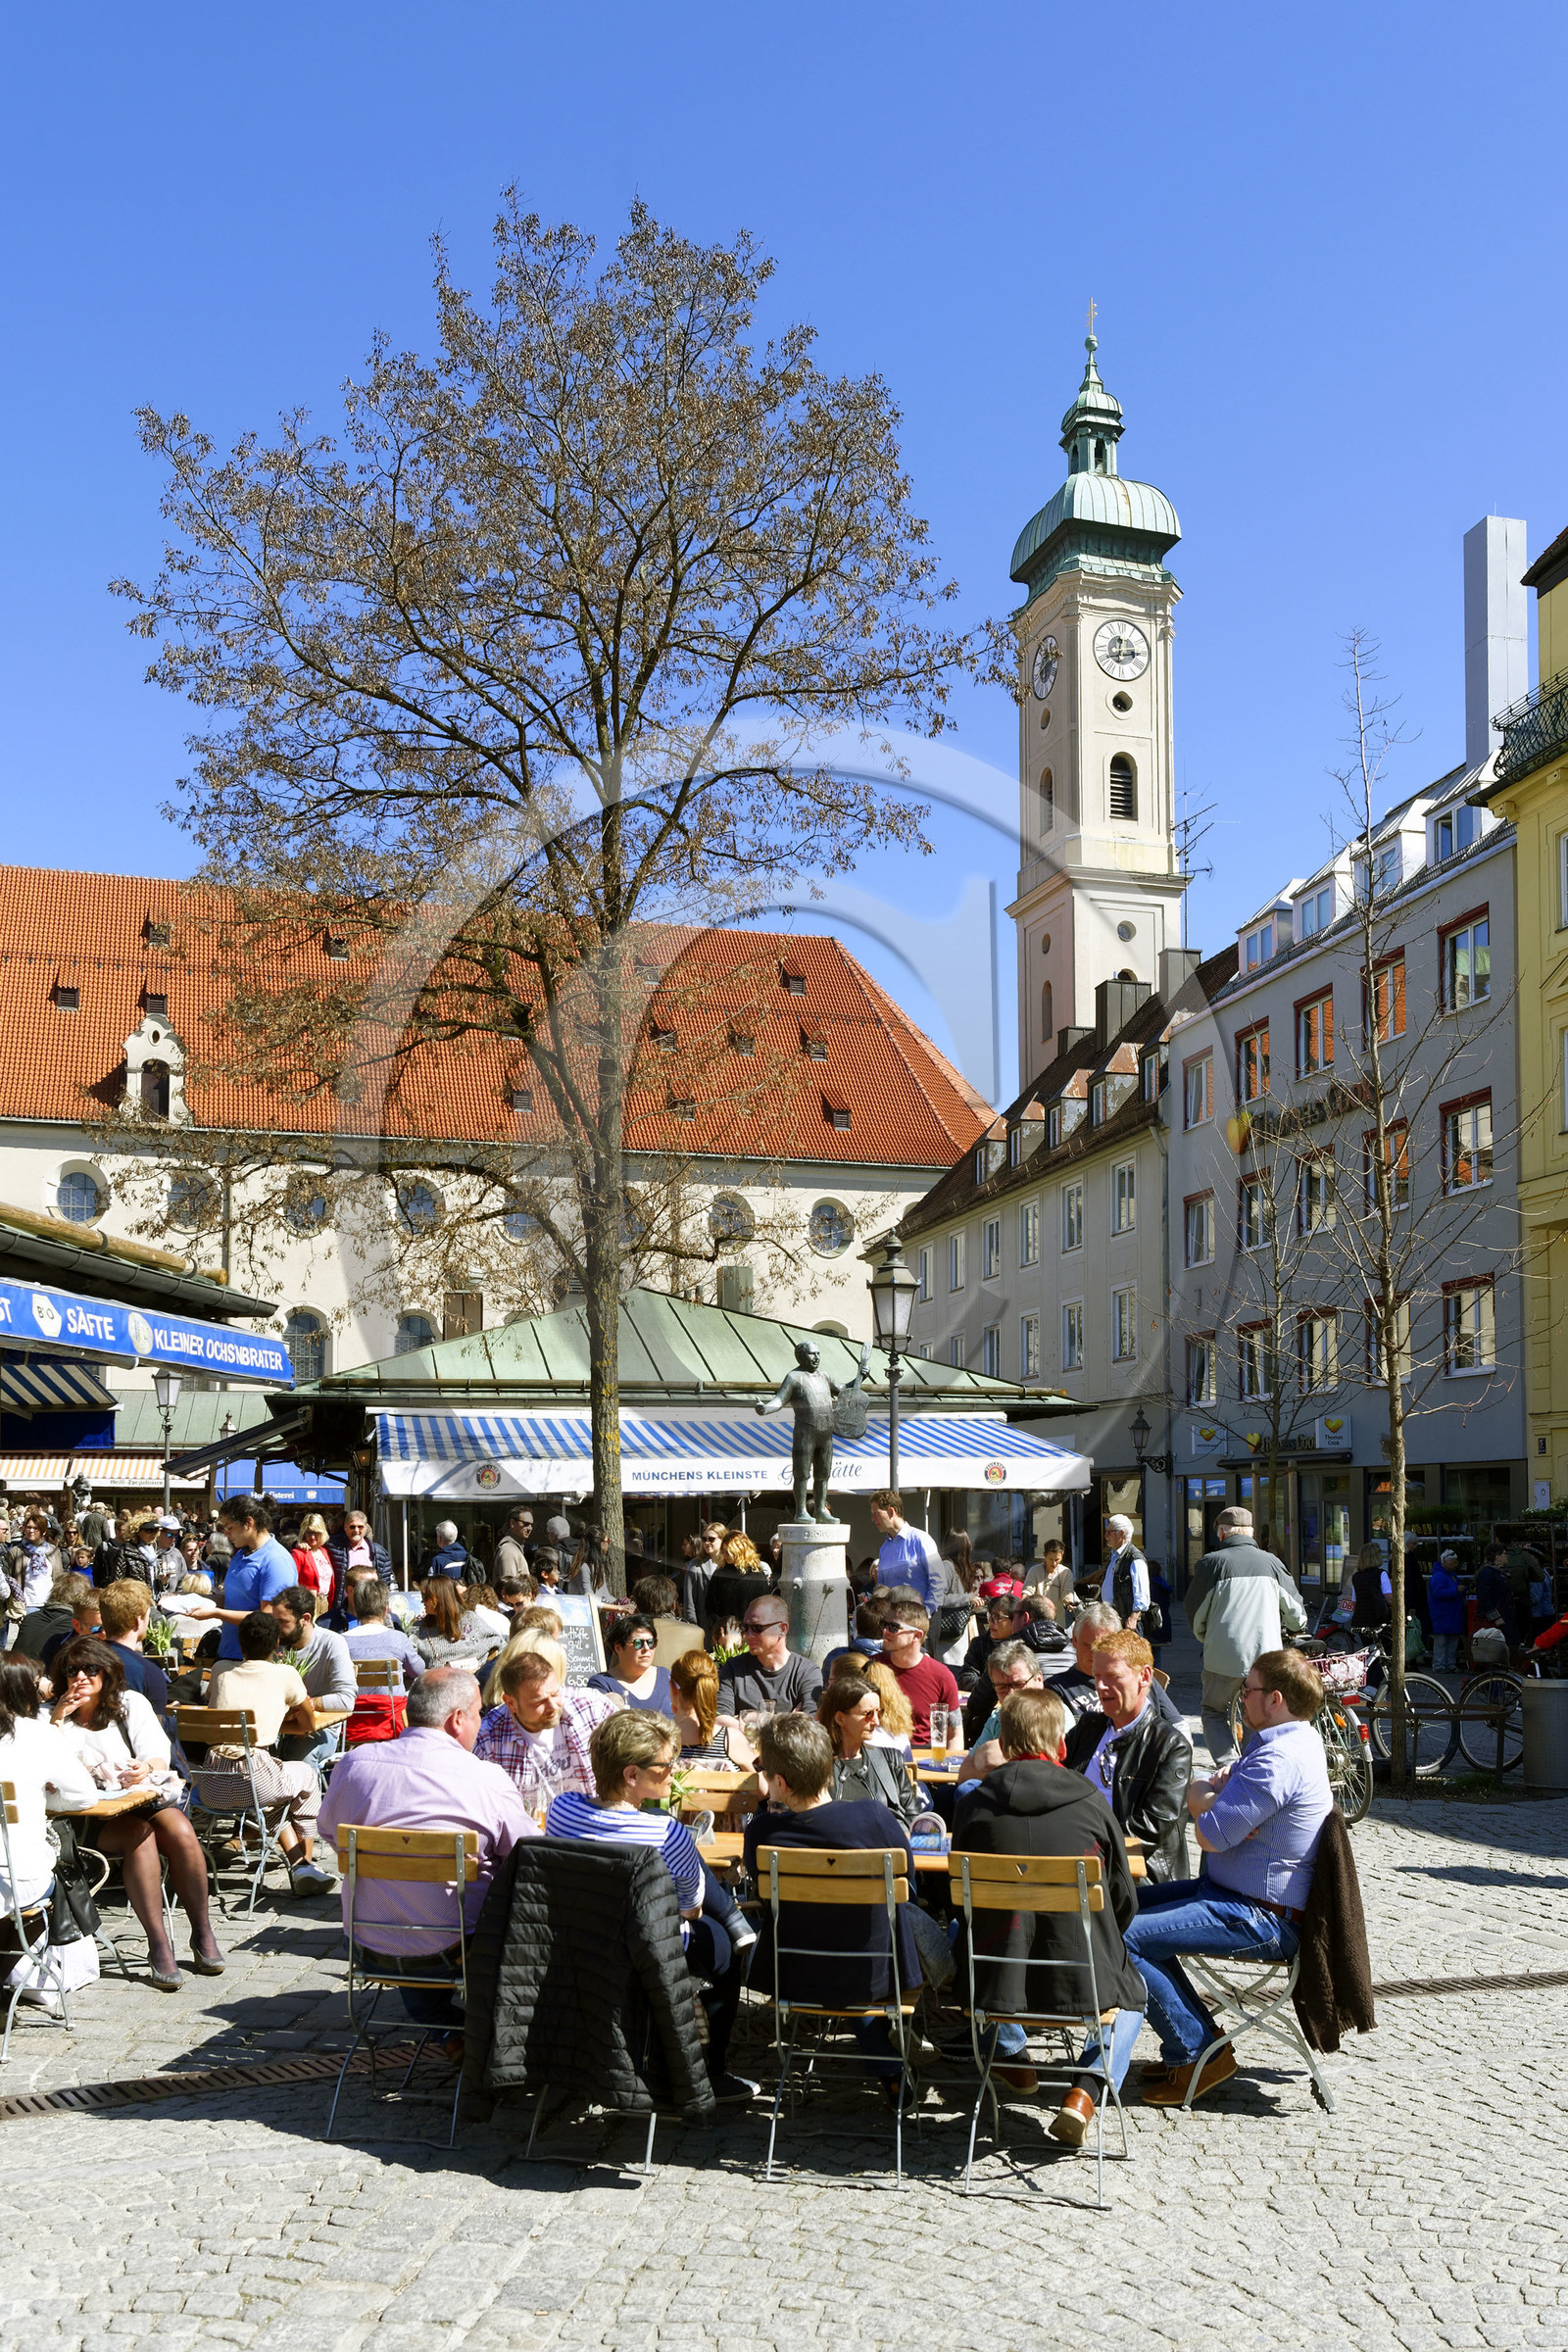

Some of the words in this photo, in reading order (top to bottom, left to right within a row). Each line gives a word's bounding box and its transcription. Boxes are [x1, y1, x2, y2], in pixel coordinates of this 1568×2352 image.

[66, 1305, 117, 1342] SÄFTE
[154, 1328, 205, 1357] KLEINER
[632, 1470, 703, 1481] MÜNCHENS
[707, 1470, 768, 1480] KLEINSTE
[1341, 1600, 1353, 1611] DB
